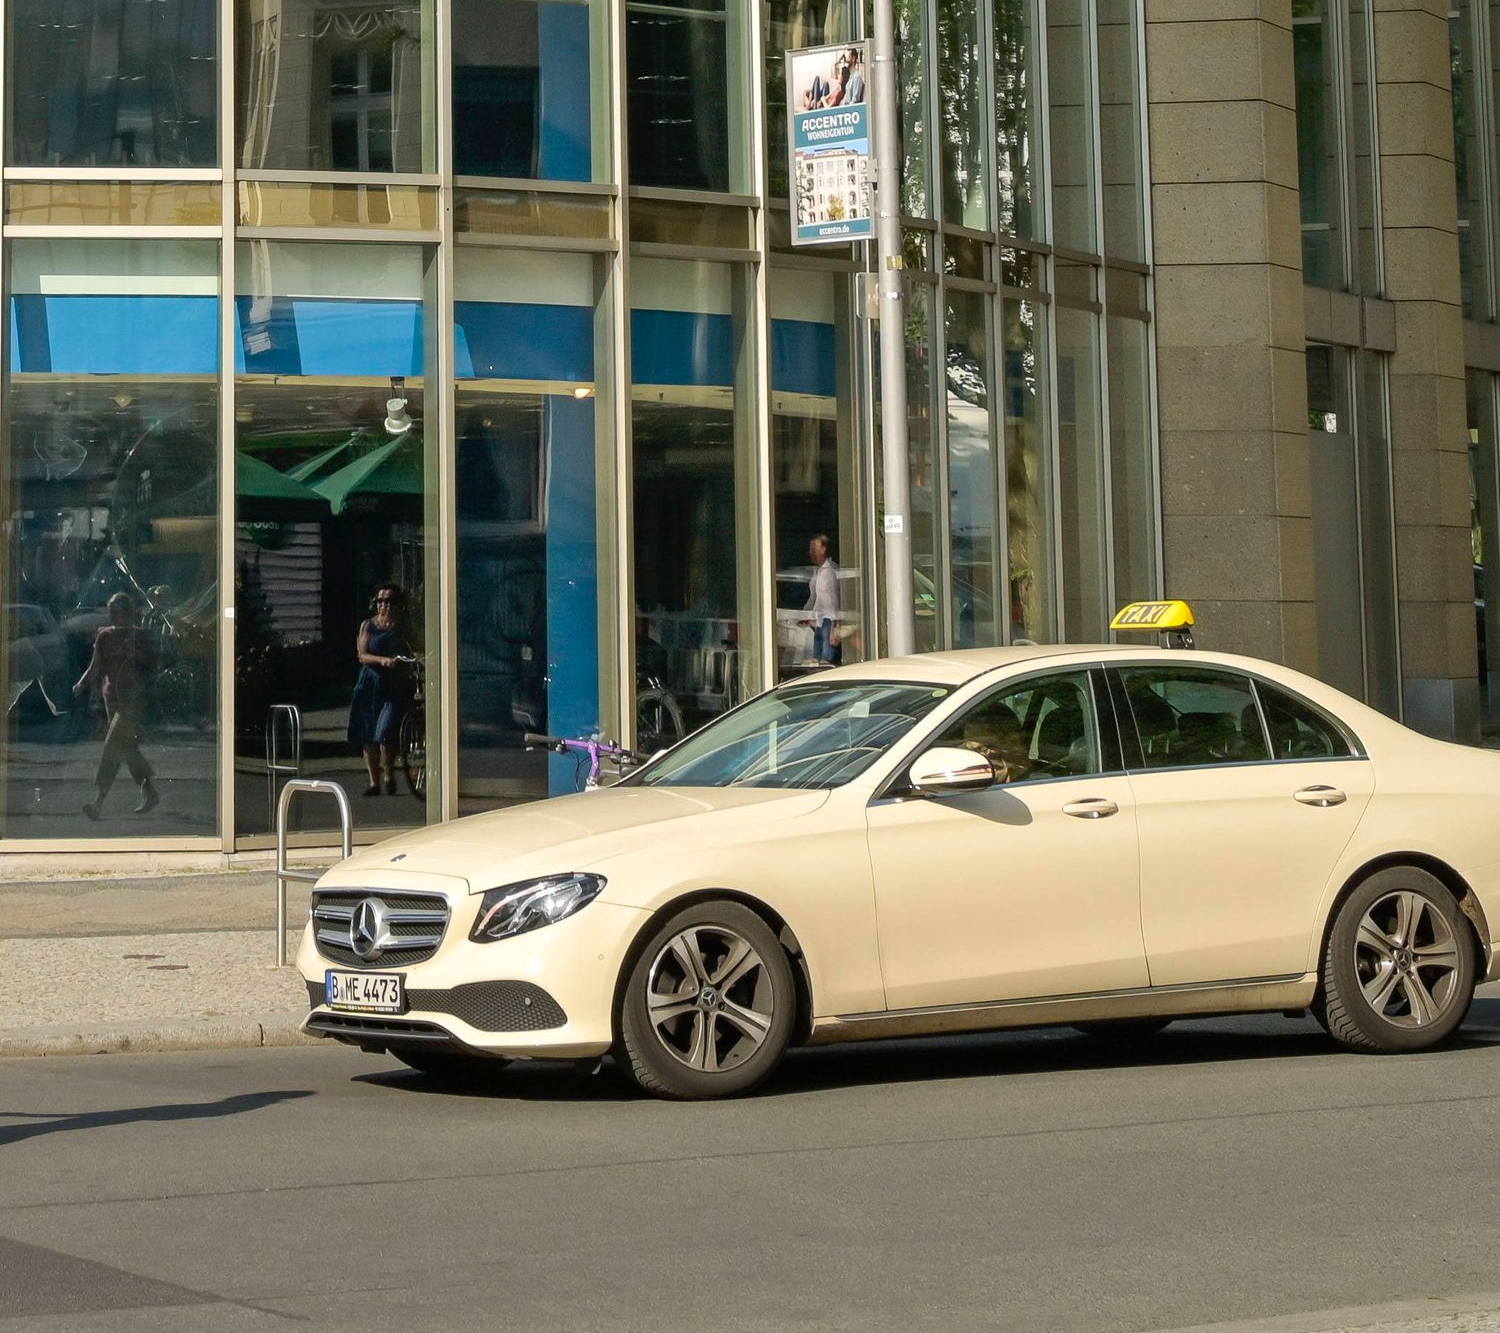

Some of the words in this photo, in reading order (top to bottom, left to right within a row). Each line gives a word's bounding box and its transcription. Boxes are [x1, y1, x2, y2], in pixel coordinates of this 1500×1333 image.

[802, 111, 860, 132] ACCENTRO
[807, 126, 855, 141] WOHNEIGENTUM
[819, 225, 850, 235] accentro.de
[1121, 605, 1169, 623] TAXI
[332, 976, 339, 999] B
[345, 977, 360, 1001] ME
[363, 978, 398, 1003] 4473
